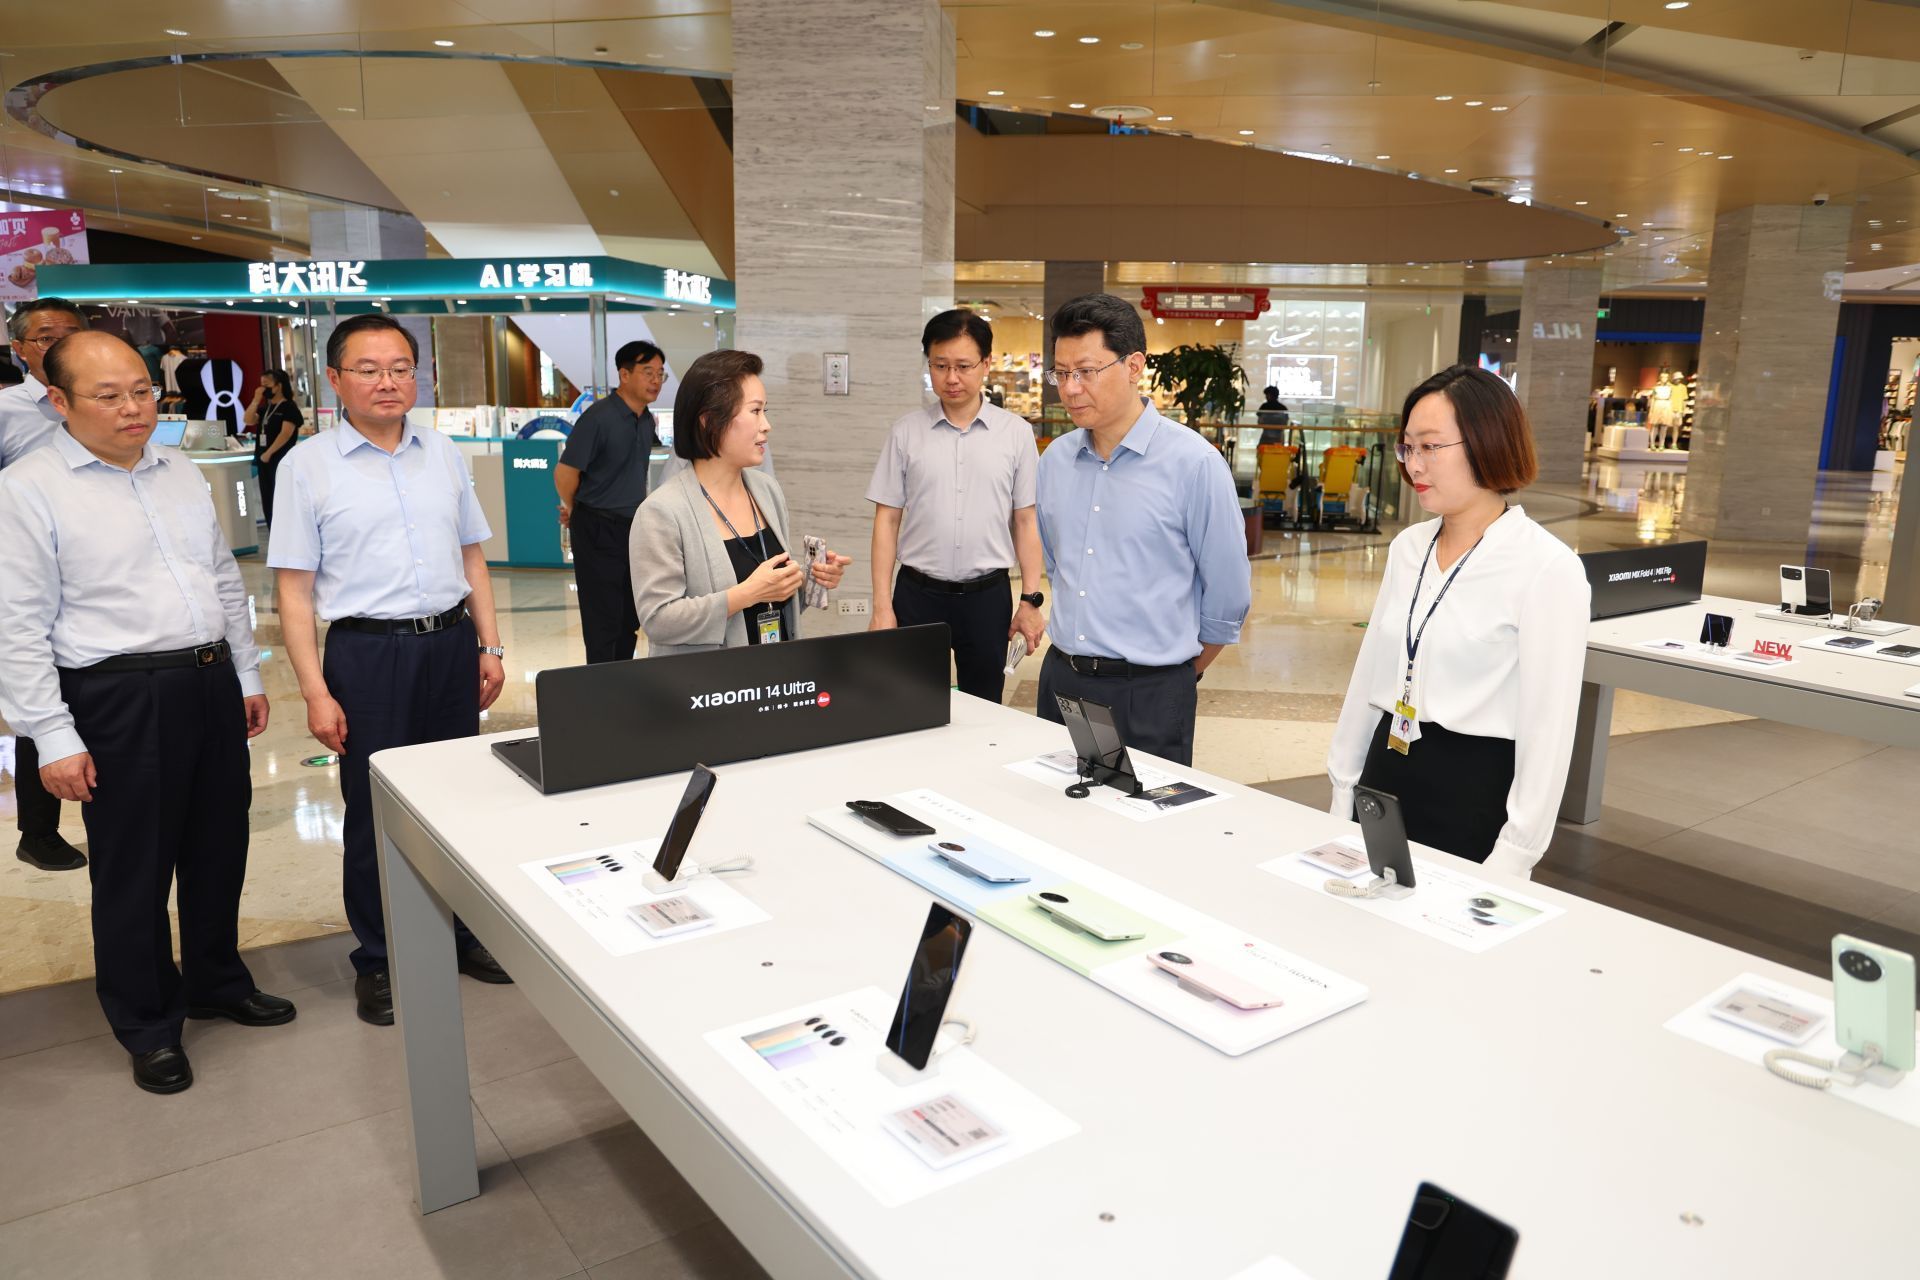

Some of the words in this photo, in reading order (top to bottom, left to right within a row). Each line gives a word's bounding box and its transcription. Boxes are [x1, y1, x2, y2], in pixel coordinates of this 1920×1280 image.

[248, 261, 368, 294] 科大讯飞
[1754, 639, 1792, 658] NEW
[690, 687, 761, 709] xiaomi
[765, 685, 780, 699] 14
[783, 681, 816, 696] Ultra
